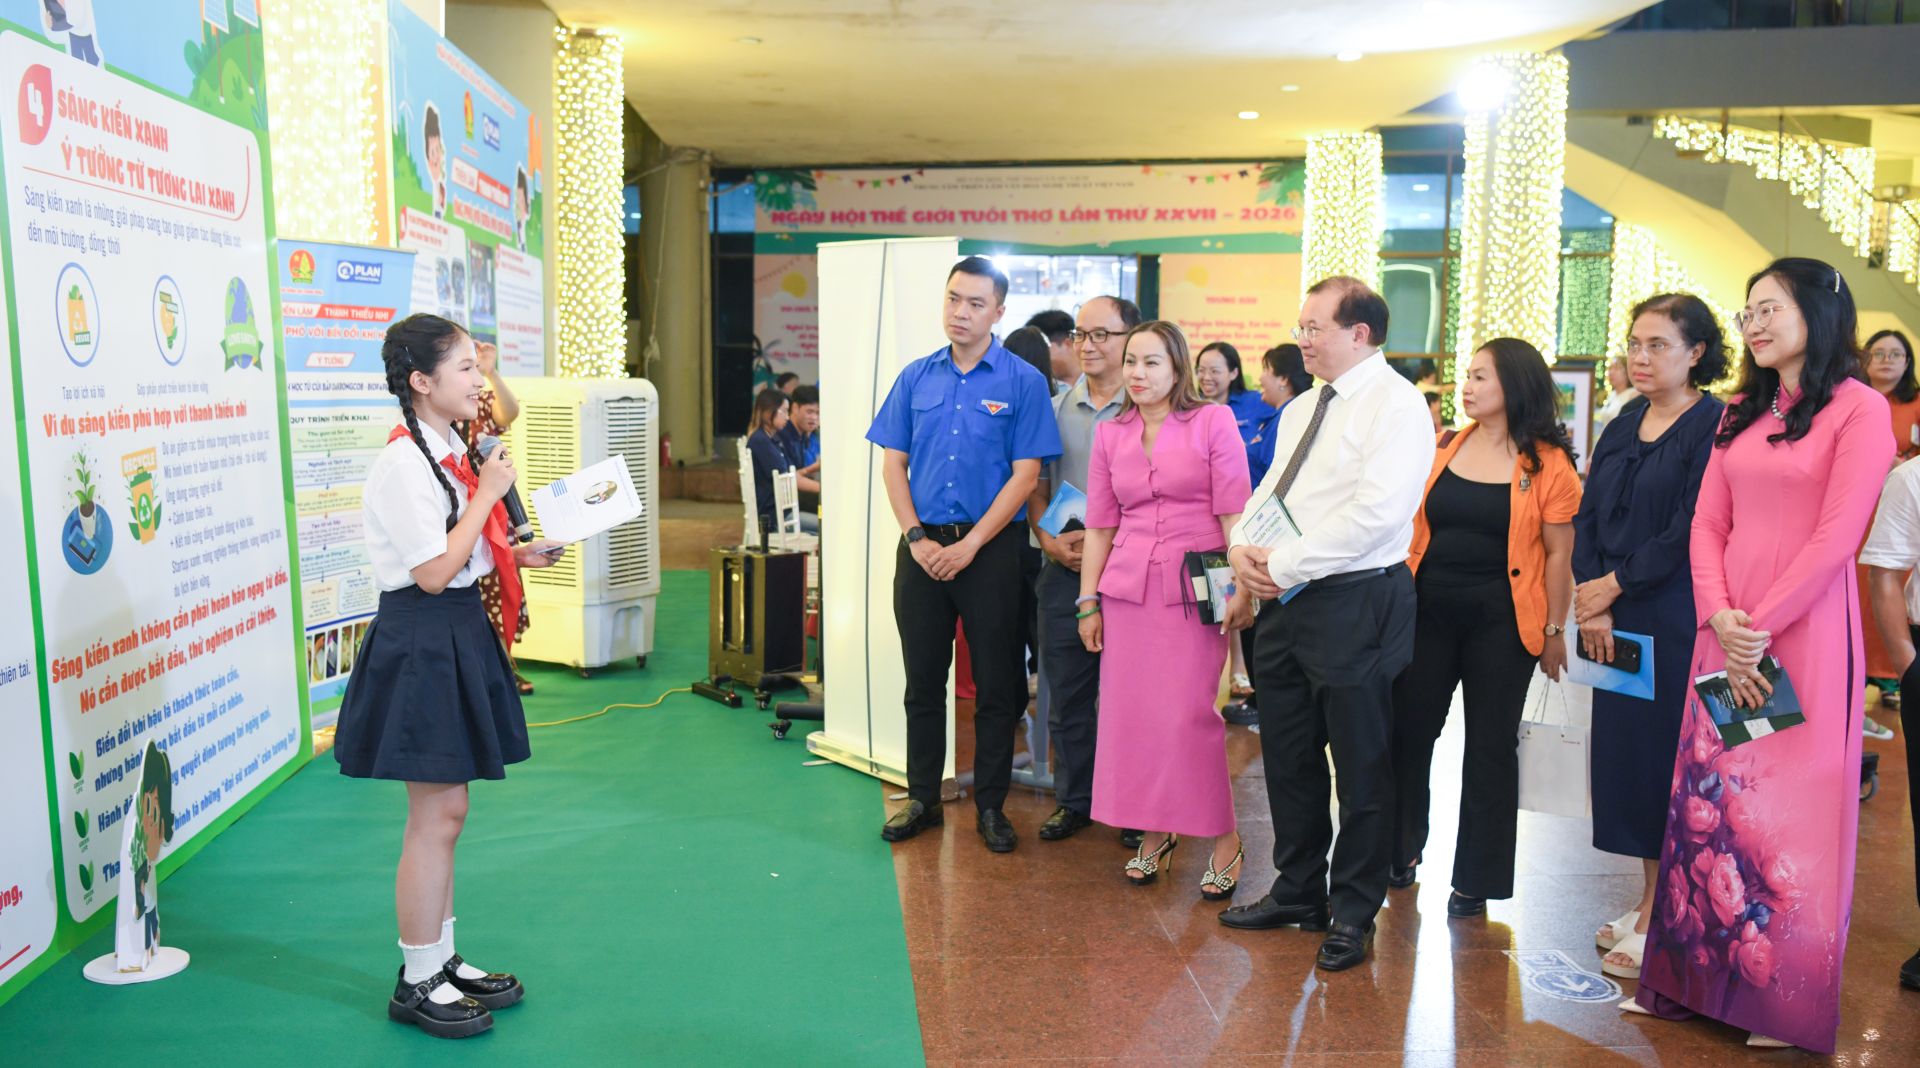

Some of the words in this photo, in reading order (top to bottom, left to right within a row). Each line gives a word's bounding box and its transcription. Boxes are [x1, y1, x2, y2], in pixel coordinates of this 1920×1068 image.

[27, 82, 43, 127] 4
[58, 86, 97, 128] SÁNG
[101, 99, 132, 140] KIẾN
[135, 117, 168, 152] XANH
[61, 134, 72, 170] Ý
[76, 144, 124, 184] TƯỞNG
[127, 158, 144, 190] TỪ
[147, 167, 187, 201] TƯƠNG
[189, 180, 205, 206] LAI
[208, 186, 235, 213] XANH
[25, 186, 45, 213] Sáng
[47, 188, 63, 212] kiến
[65, 197, 82, 216] xanh
[771, 205, 825, 226] NGÀY
[830, 208, 866, 226] HỘI
[870, 202, 907, 223] THẾ
[912, 205, 955, 223] GIỚI
[958, 204, 1007, 223] TUỔI
[1011, 207, 1054, 222] THƠ
[1058, 204, 1100, 222] LẦN
[1104, 203, 1149, 221] THỨ
[1153, 208, 1216, 221] XXVII
[1239, 207, 1296, 221] 2026
[355, 265, 381, 277] PLAN
[43, 413, 57, 437] Ví
[61, 414, 75, 440] dụ
[79, 411, 105, 437] sáng
[108, 404, 130, 431] kiến
[133, 407, 151, 432] phù
[153, 407, 171, 430] hợp
[173, 403, 187, 424] với
[189, 403, 212, 422] thanh
[214, 398, 234, 419] thiếu
[236, 400, 247, 417] nhi
[52, 657, 83, 683] Sáng
[85, 637, 110, 669] kiến
[112, 629, 139, 657] xanh
[141, 619, 171, 645] không
[173, 605, 189, 631] cần
[191, 599, 209, 628] phải
[211, 592, 230, 615] hoàn
[247, 581, 264, 601] ngay
[266, 574, 272, 591] từ
[19, 659, 31, 678] tai.
[80, 688, 96, 714] Nó
[98, 675, 119, 705] cần
[120, 667, 147, 693] được
[148, 652, 165, 680] bắt
[167, 644, 187, 671] đầu,
[189, 636, 203, 660] thử
[205, 626, 234, 654] nghiệm
[235, 618, 245, 637] và
[246, 611, 256, 632] cải
[258, 605, 277, 625] thiện.
[95, 764, 123, 792] nhưng
[98, 805, 121, 833] Hành
[102, 861, 121, 883] Tha
